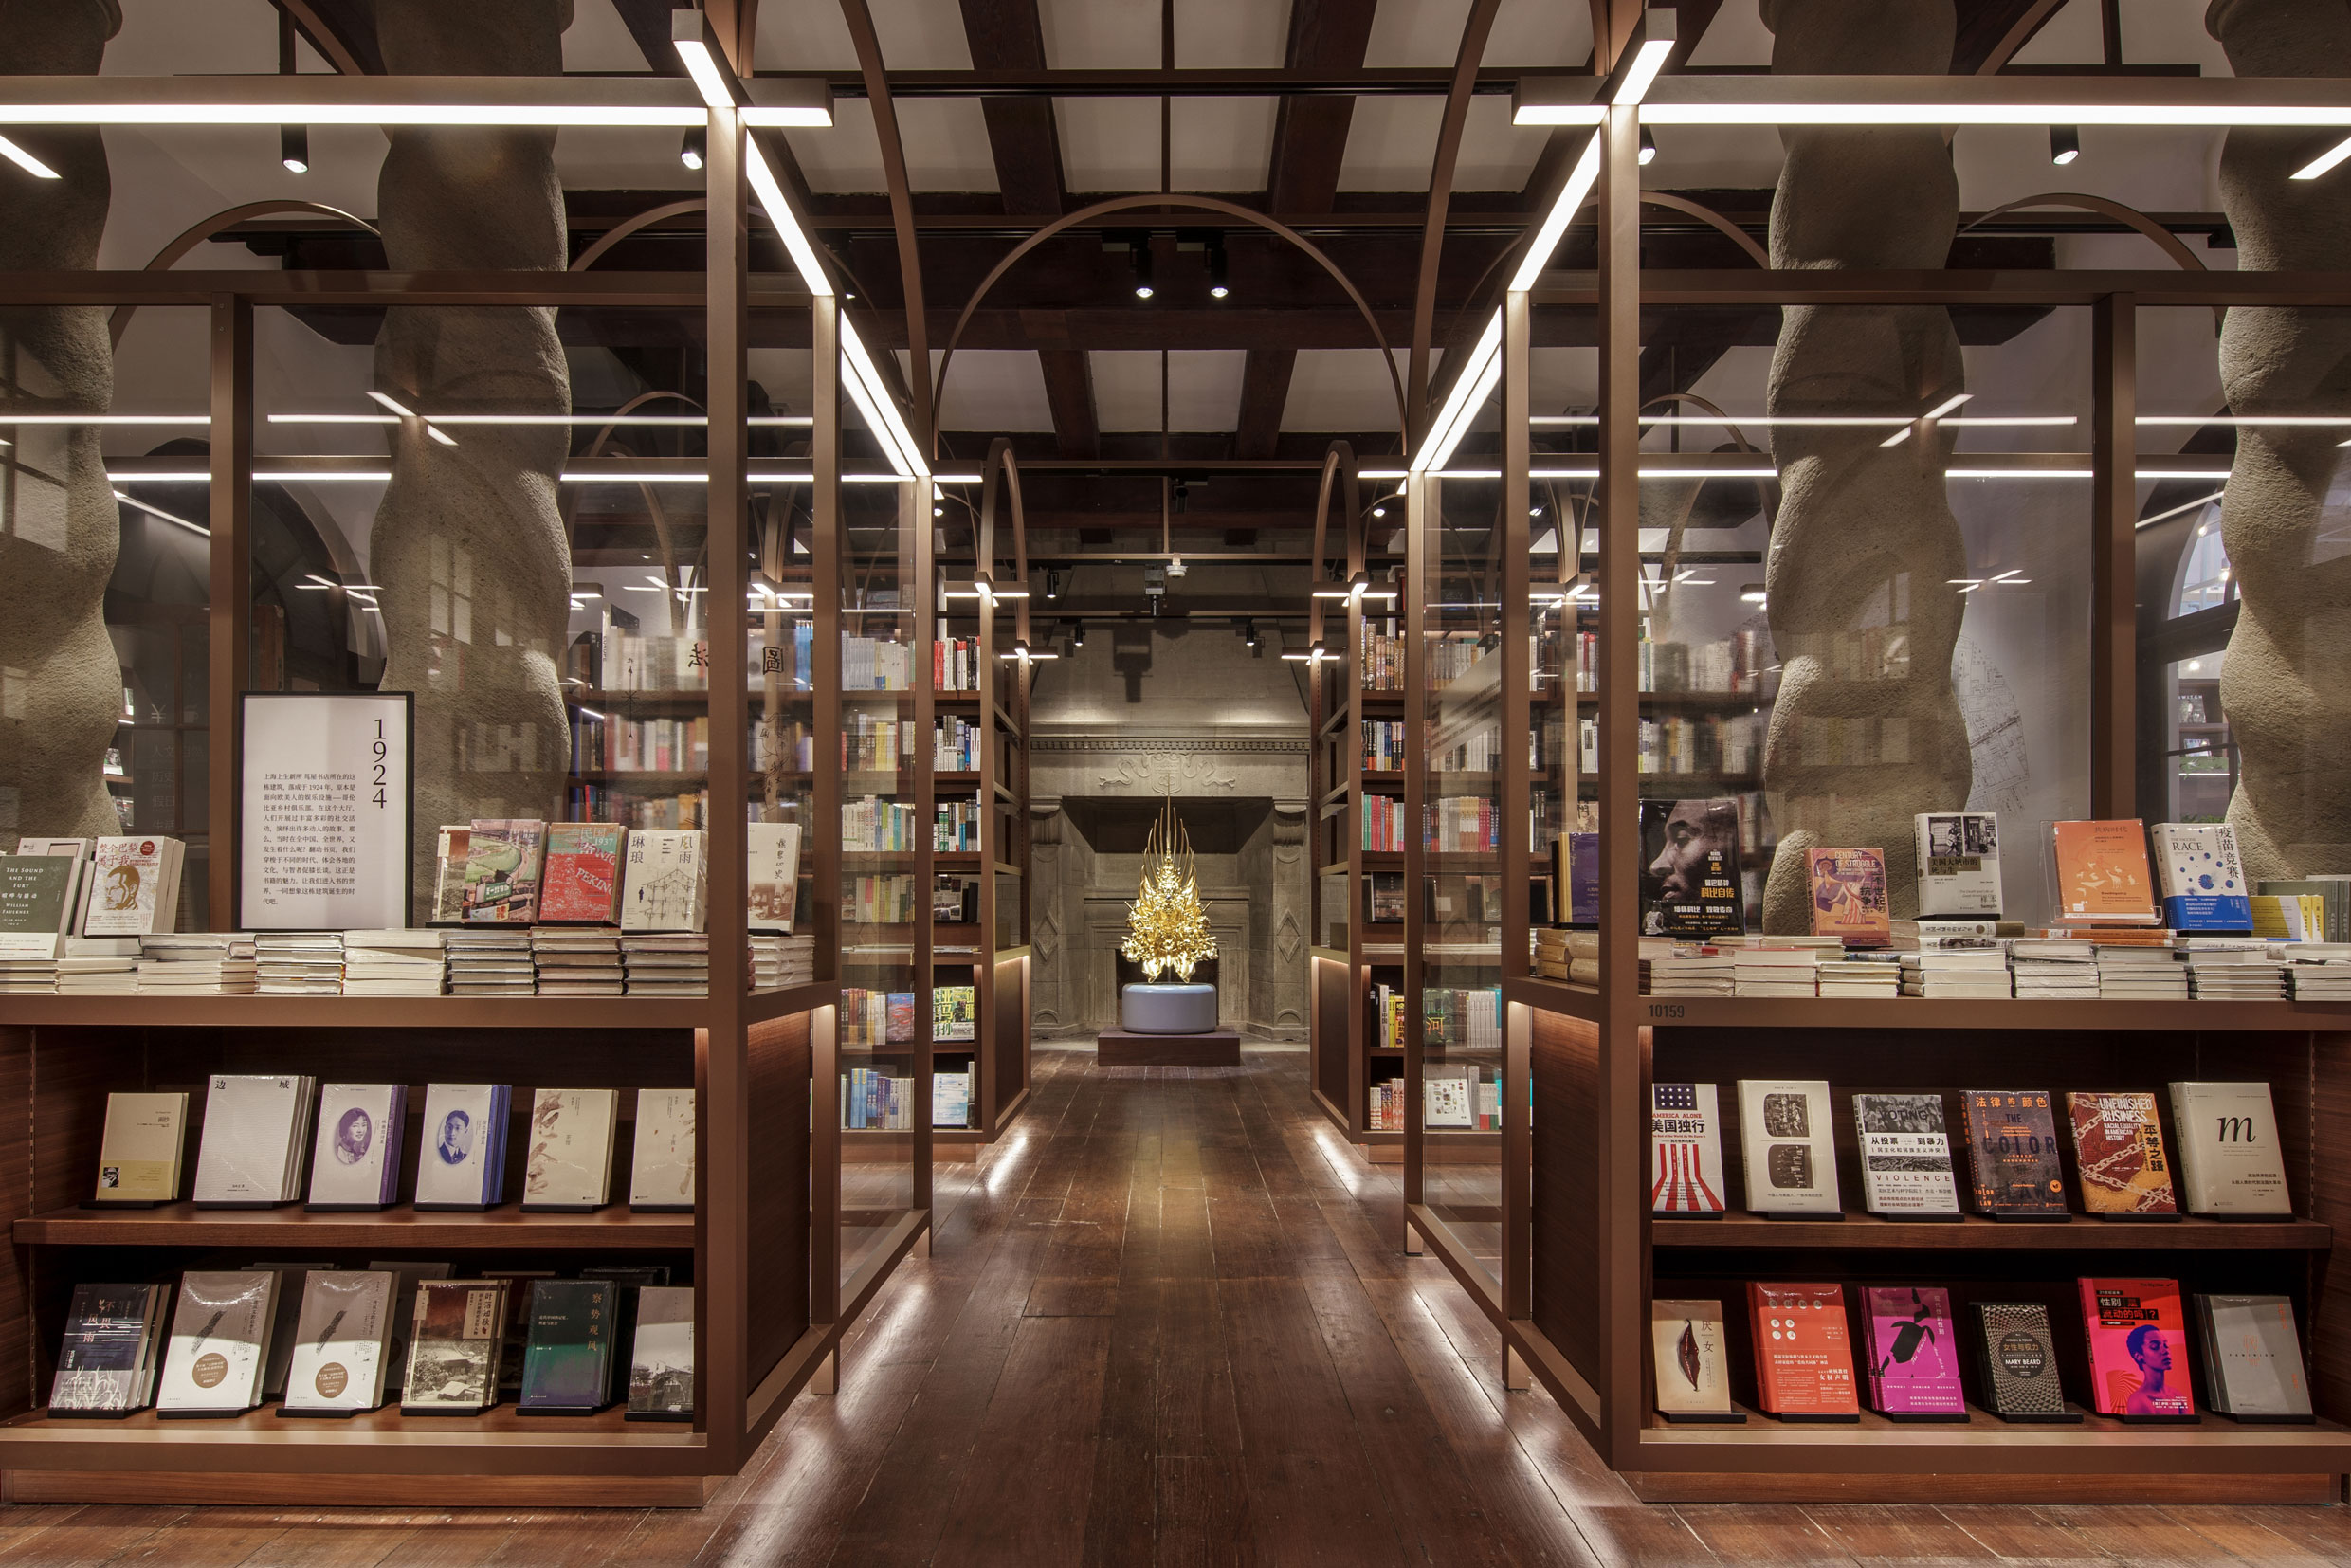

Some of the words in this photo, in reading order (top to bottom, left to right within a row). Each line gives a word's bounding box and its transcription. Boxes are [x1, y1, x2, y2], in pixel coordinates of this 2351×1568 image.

[372, 718, 388, 809] 1924
[595, 837, 614, 846] 1937
[2172, 842, 2204, 851] RACE
[2218, 826, 2239, 879] 疫苗竞赛
[1930, 857, 1978, 866] 美国大城市的
[1701, 887, 1735, 898] 科比自传
[1649, 1004, 1686, 1019] 10159
[215, 1080, 227, 1090] 边
[1976, 1096, 2048, 1108] 法律的颜色
[2099, 1098, 2153, 1110] UNFINISHED
[1880, 1110, 1928, 1120] VOTING
[2006, 1114, 2022, 1123] THE
[2102, 1110, 2148, 1122] BUSINESS
[1651, 1119, 1705, 1133] 美国独行
[2216, 1116, 2256, 1143] m
[1871, 1137, 1898, 1145] 从投票
[1982, 1136, 2057, 1155] COLOR
[2144, 1124, 2163, 1172] 平等之路
[2100, 1298, 2121, 1306] 性别
[588, 1293, 602, 1351] 察势观风
